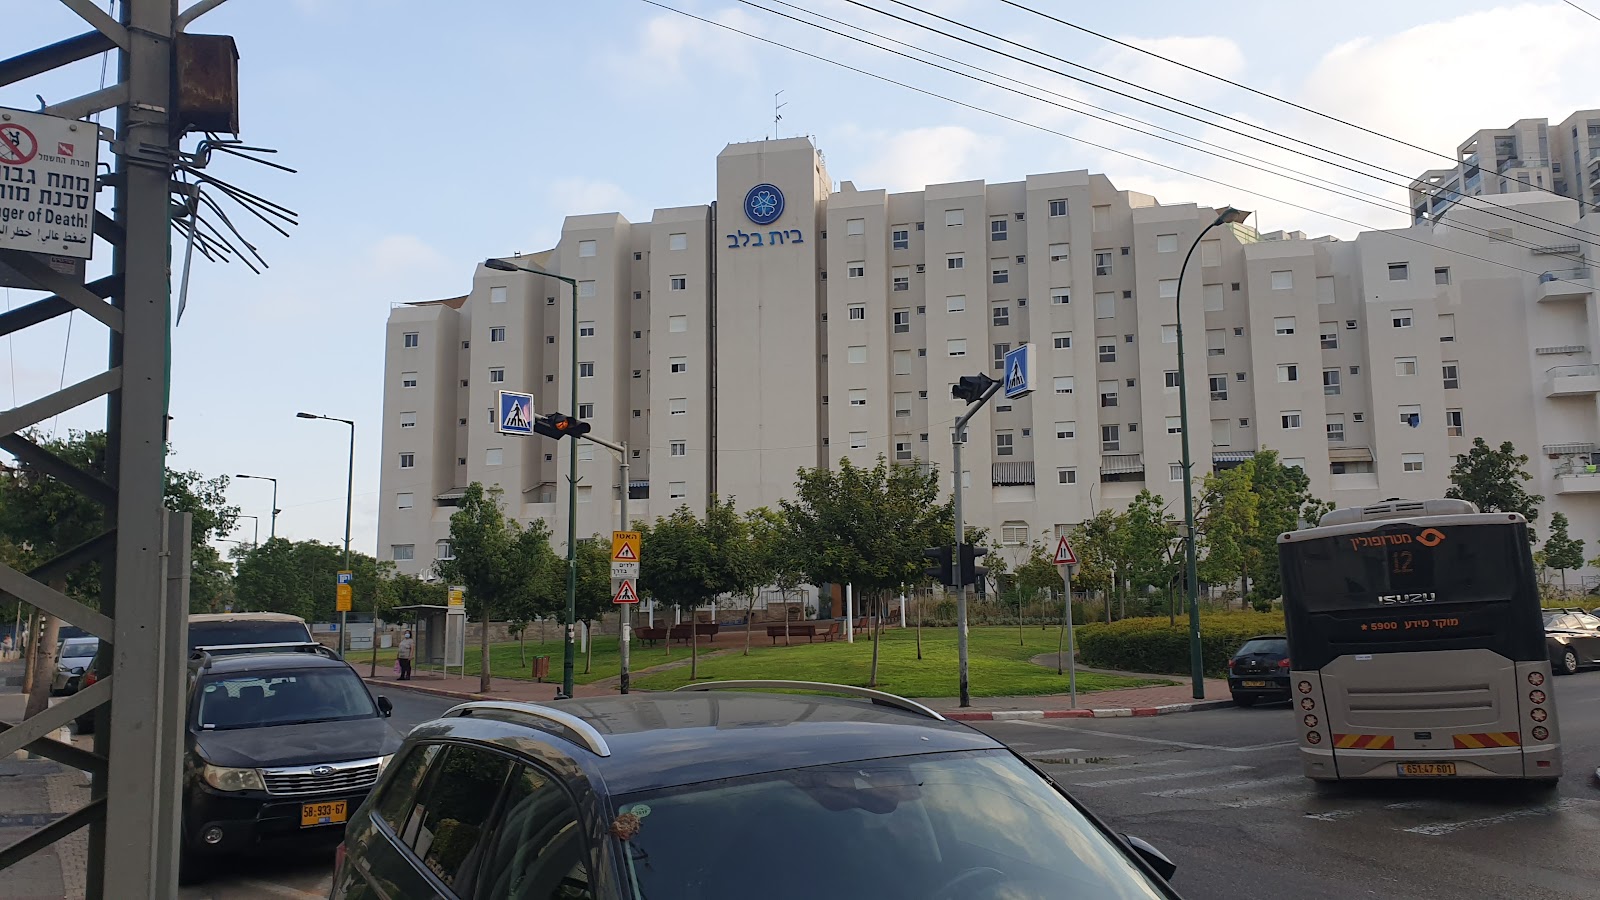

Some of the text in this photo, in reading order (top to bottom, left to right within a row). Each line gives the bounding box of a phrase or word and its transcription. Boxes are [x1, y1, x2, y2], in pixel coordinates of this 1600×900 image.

[38, 152, 90, 168] חברת החשמל
[0, 165, 90, 193] מתח גבו
[39, 189, 89, 210] סכנת
[0, 207, 88, 228] ger of Death!
[727, 229, 804, 248] בית בלב
[1350, 533, 1413, 551] מטרופולין
[1392, 550, 1414, 573] 12
[1378, 592, 1436, 605] ISUZU
[1404, 620, 1430, 630] מידע
[1432, 618, 1459, 629] מוקד
